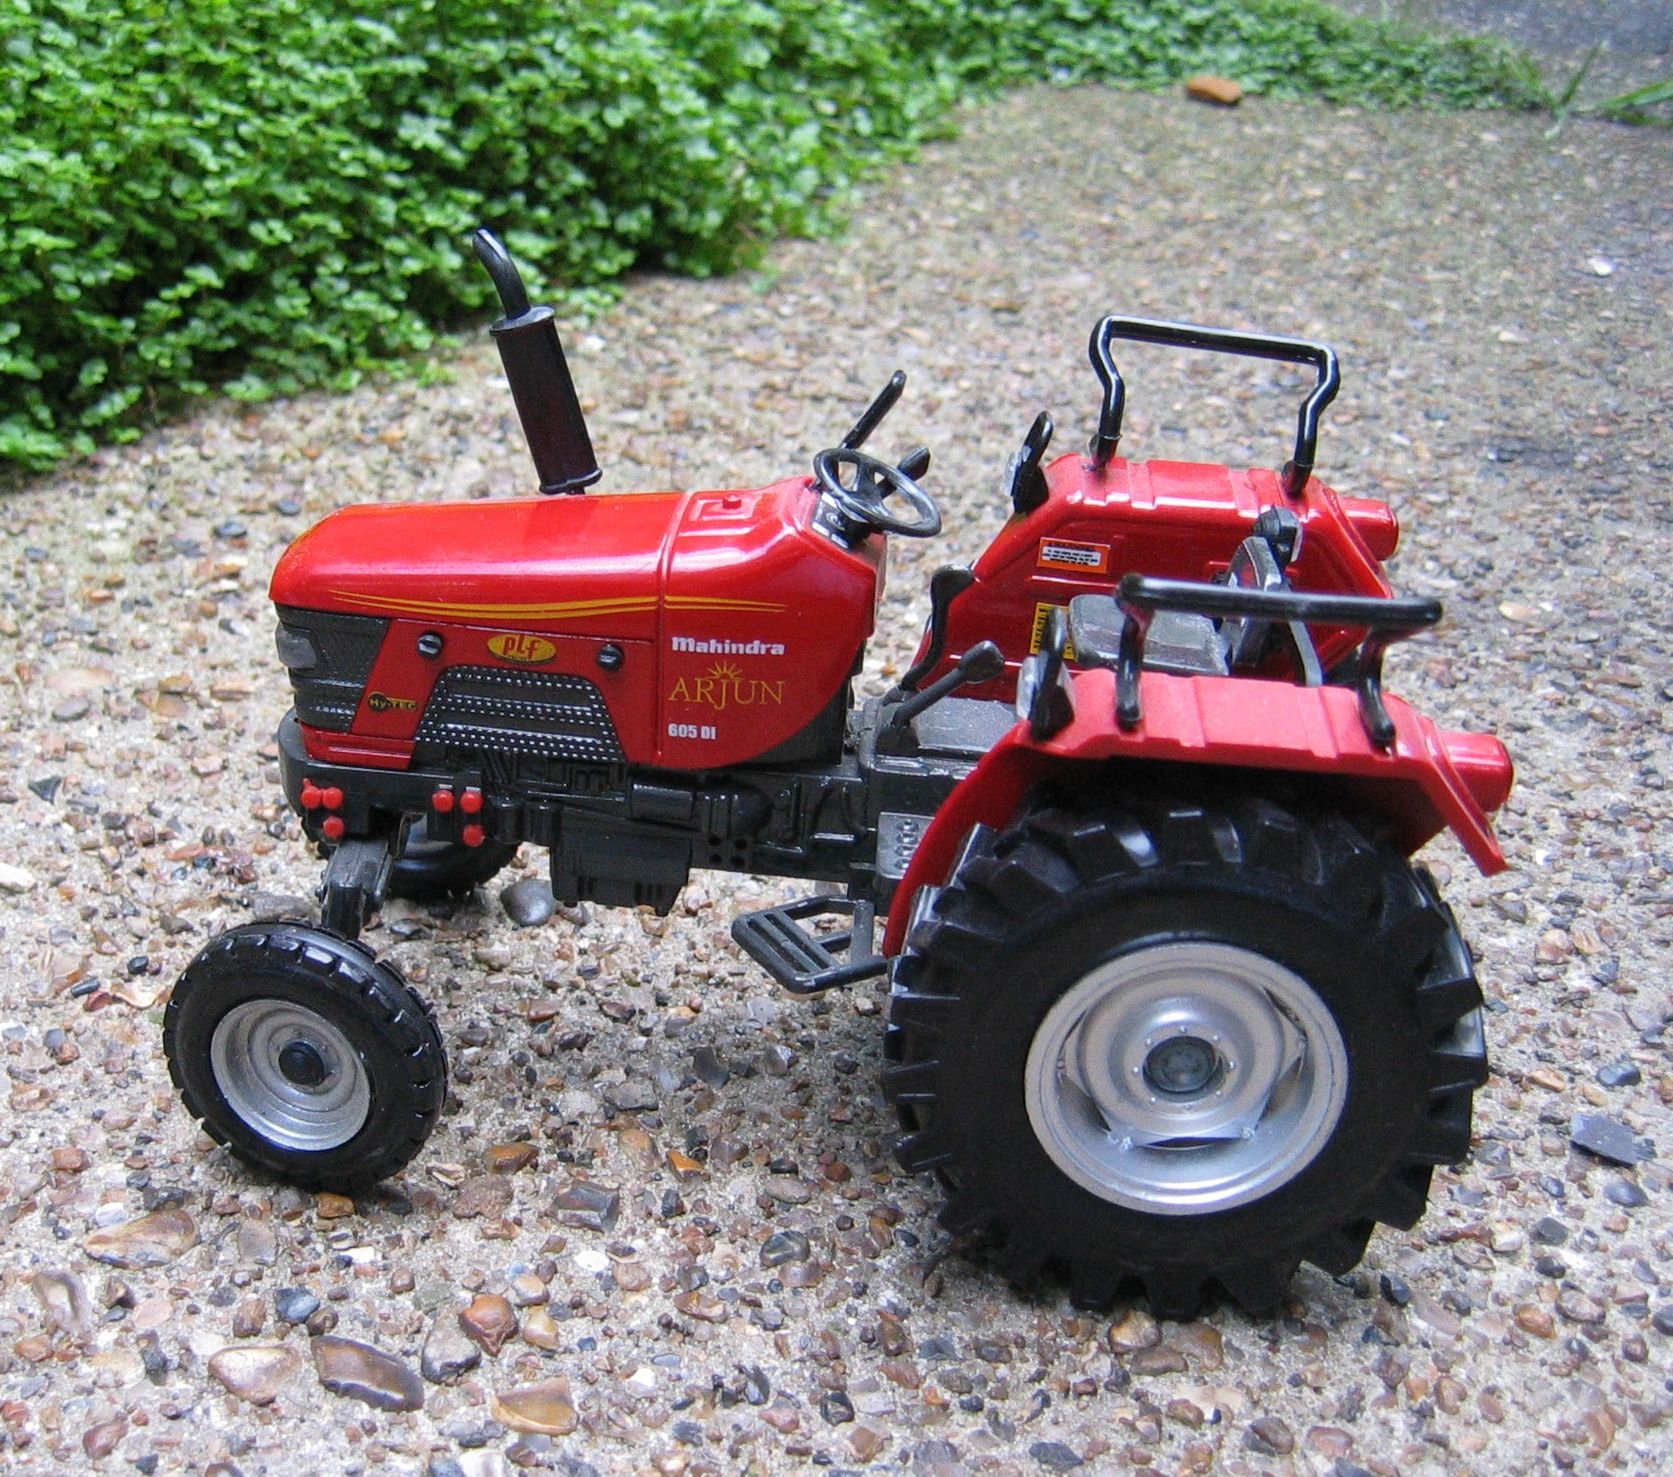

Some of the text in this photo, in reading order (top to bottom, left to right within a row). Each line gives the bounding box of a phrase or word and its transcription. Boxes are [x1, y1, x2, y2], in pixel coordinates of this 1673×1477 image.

[671, 636, 785, 656] Mahindra
[668, 676, 784, 710] ARJUN
[668, 723, 716, 740] 605 DI
